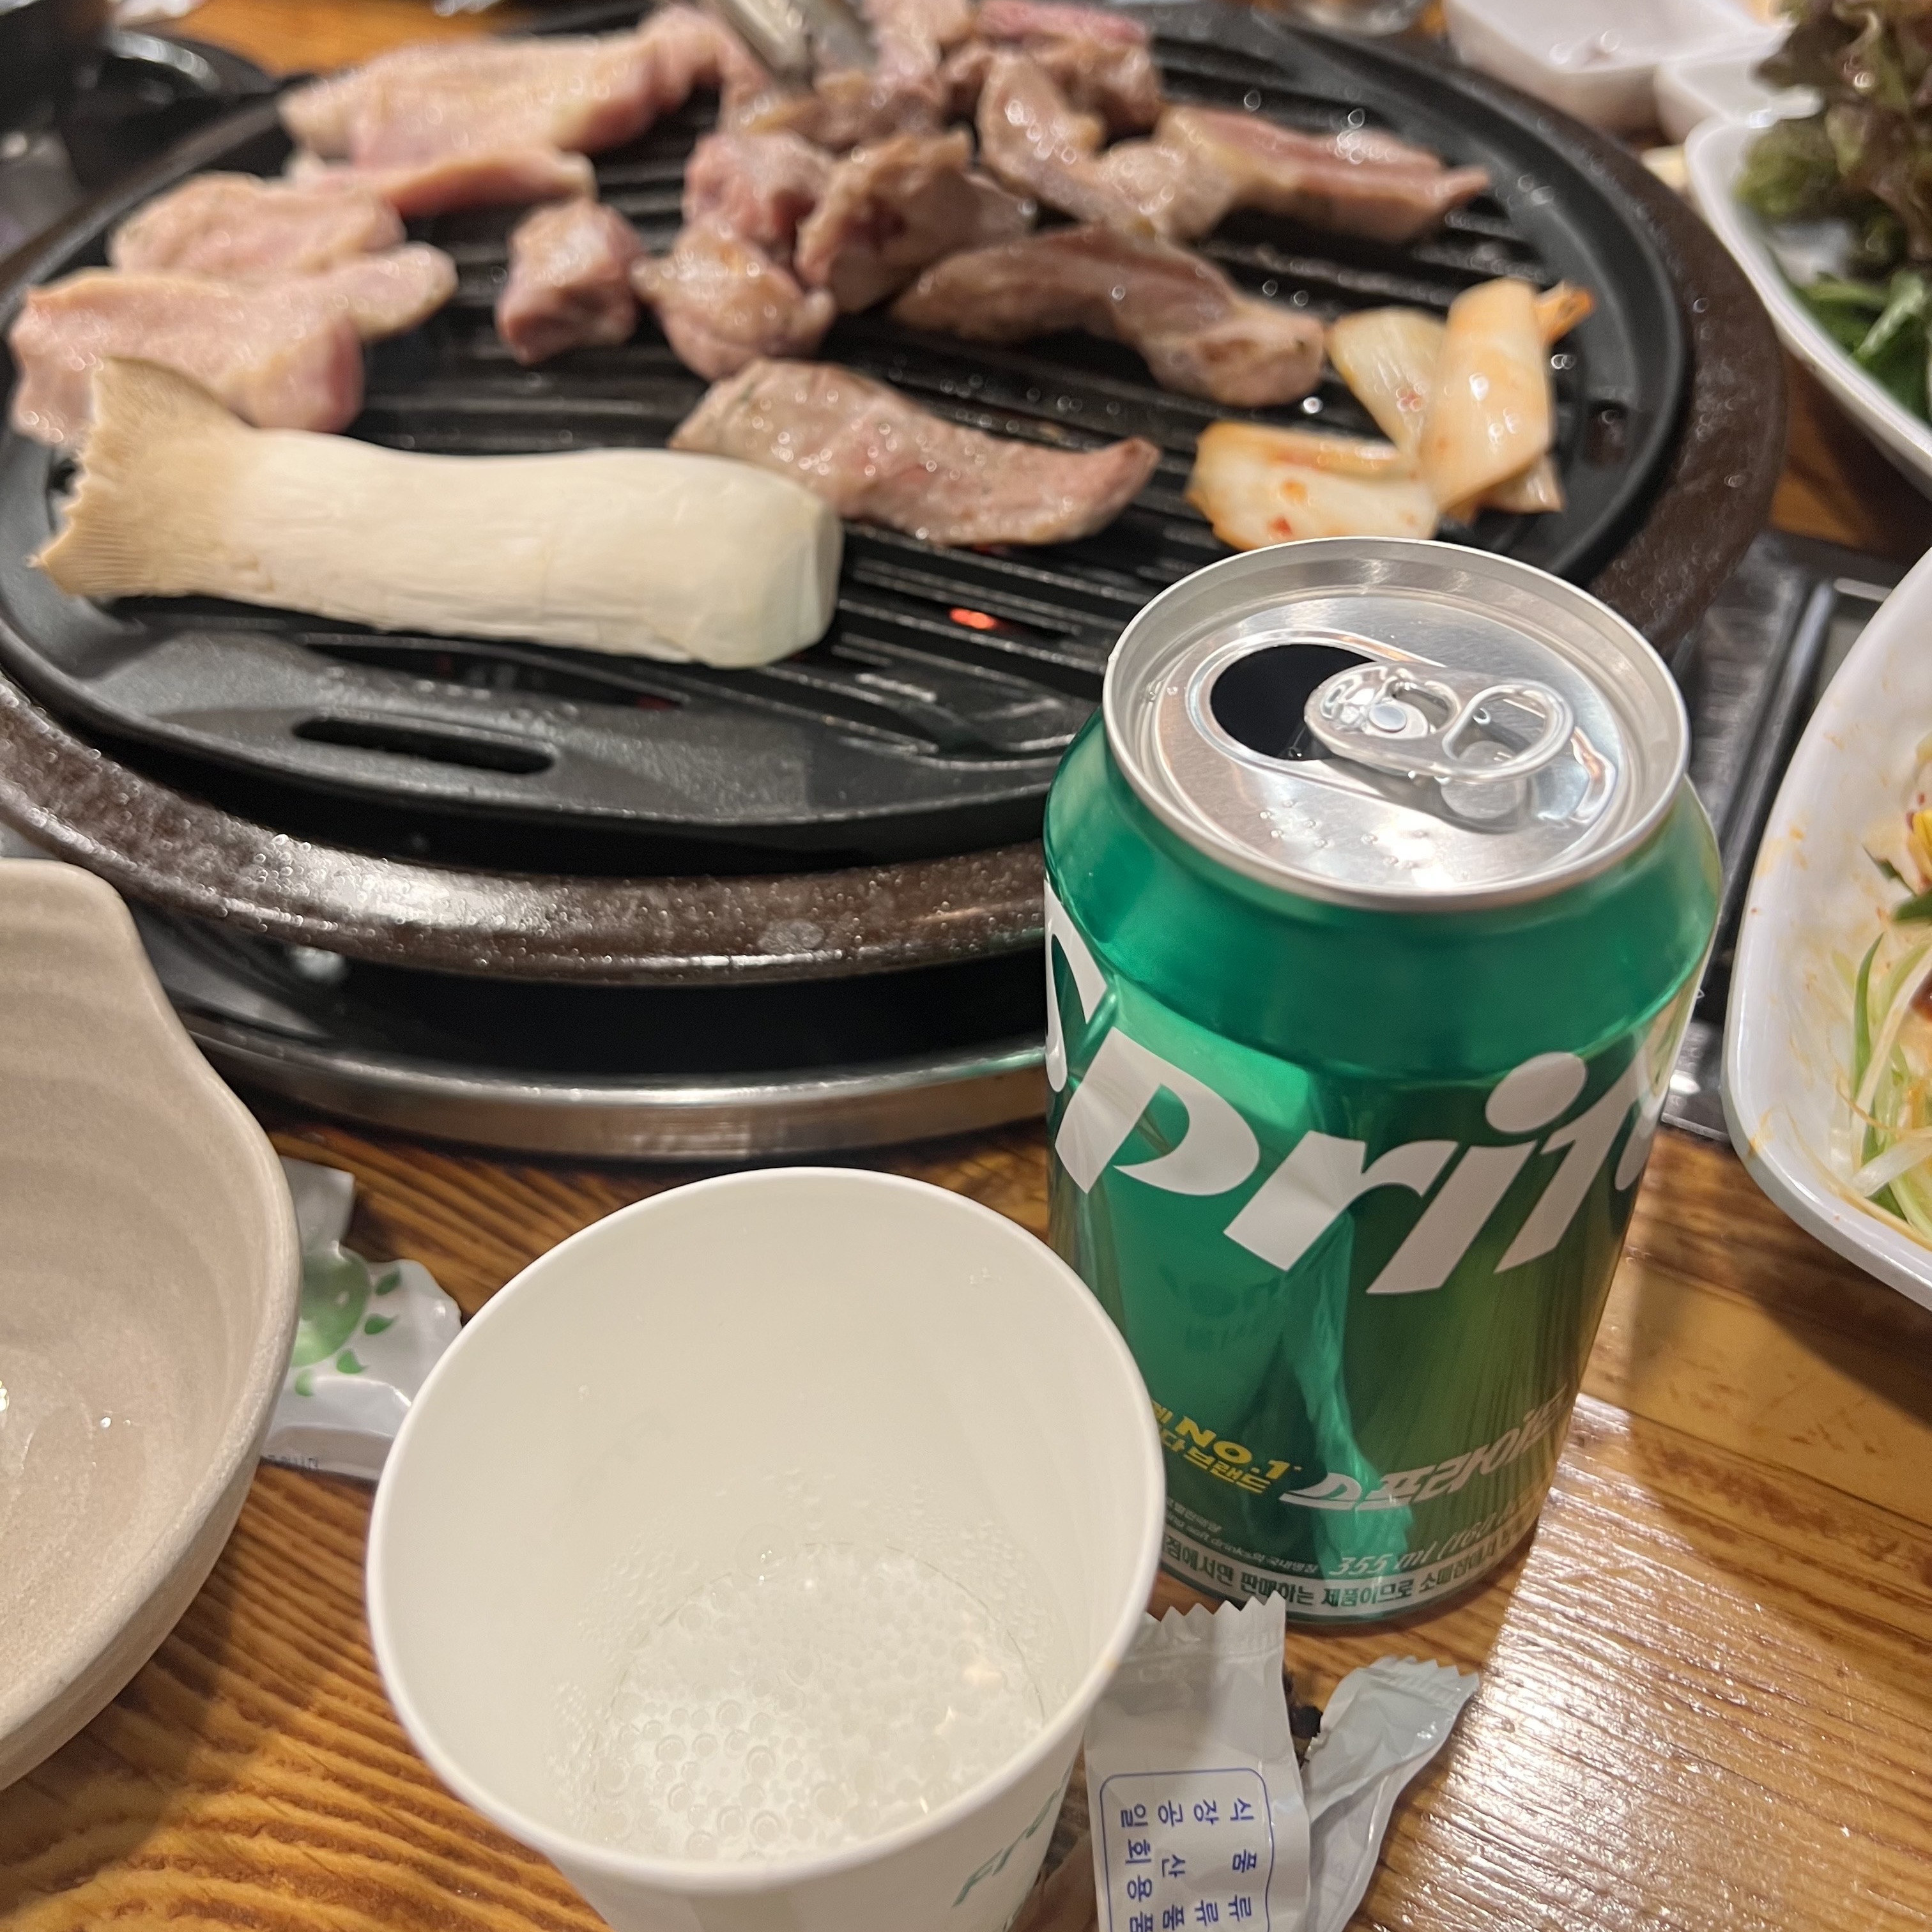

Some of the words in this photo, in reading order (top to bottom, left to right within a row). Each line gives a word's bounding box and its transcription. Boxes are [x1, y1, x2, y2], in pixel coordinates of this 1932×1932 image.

[1184, 1446, 1271, 1494] 브랜드
[1328, 1552, 1393, 1576] 355
[1393, 1540, 1437, 1570] ml
[1321, 1578, 1415, 1607] 제품이므로
